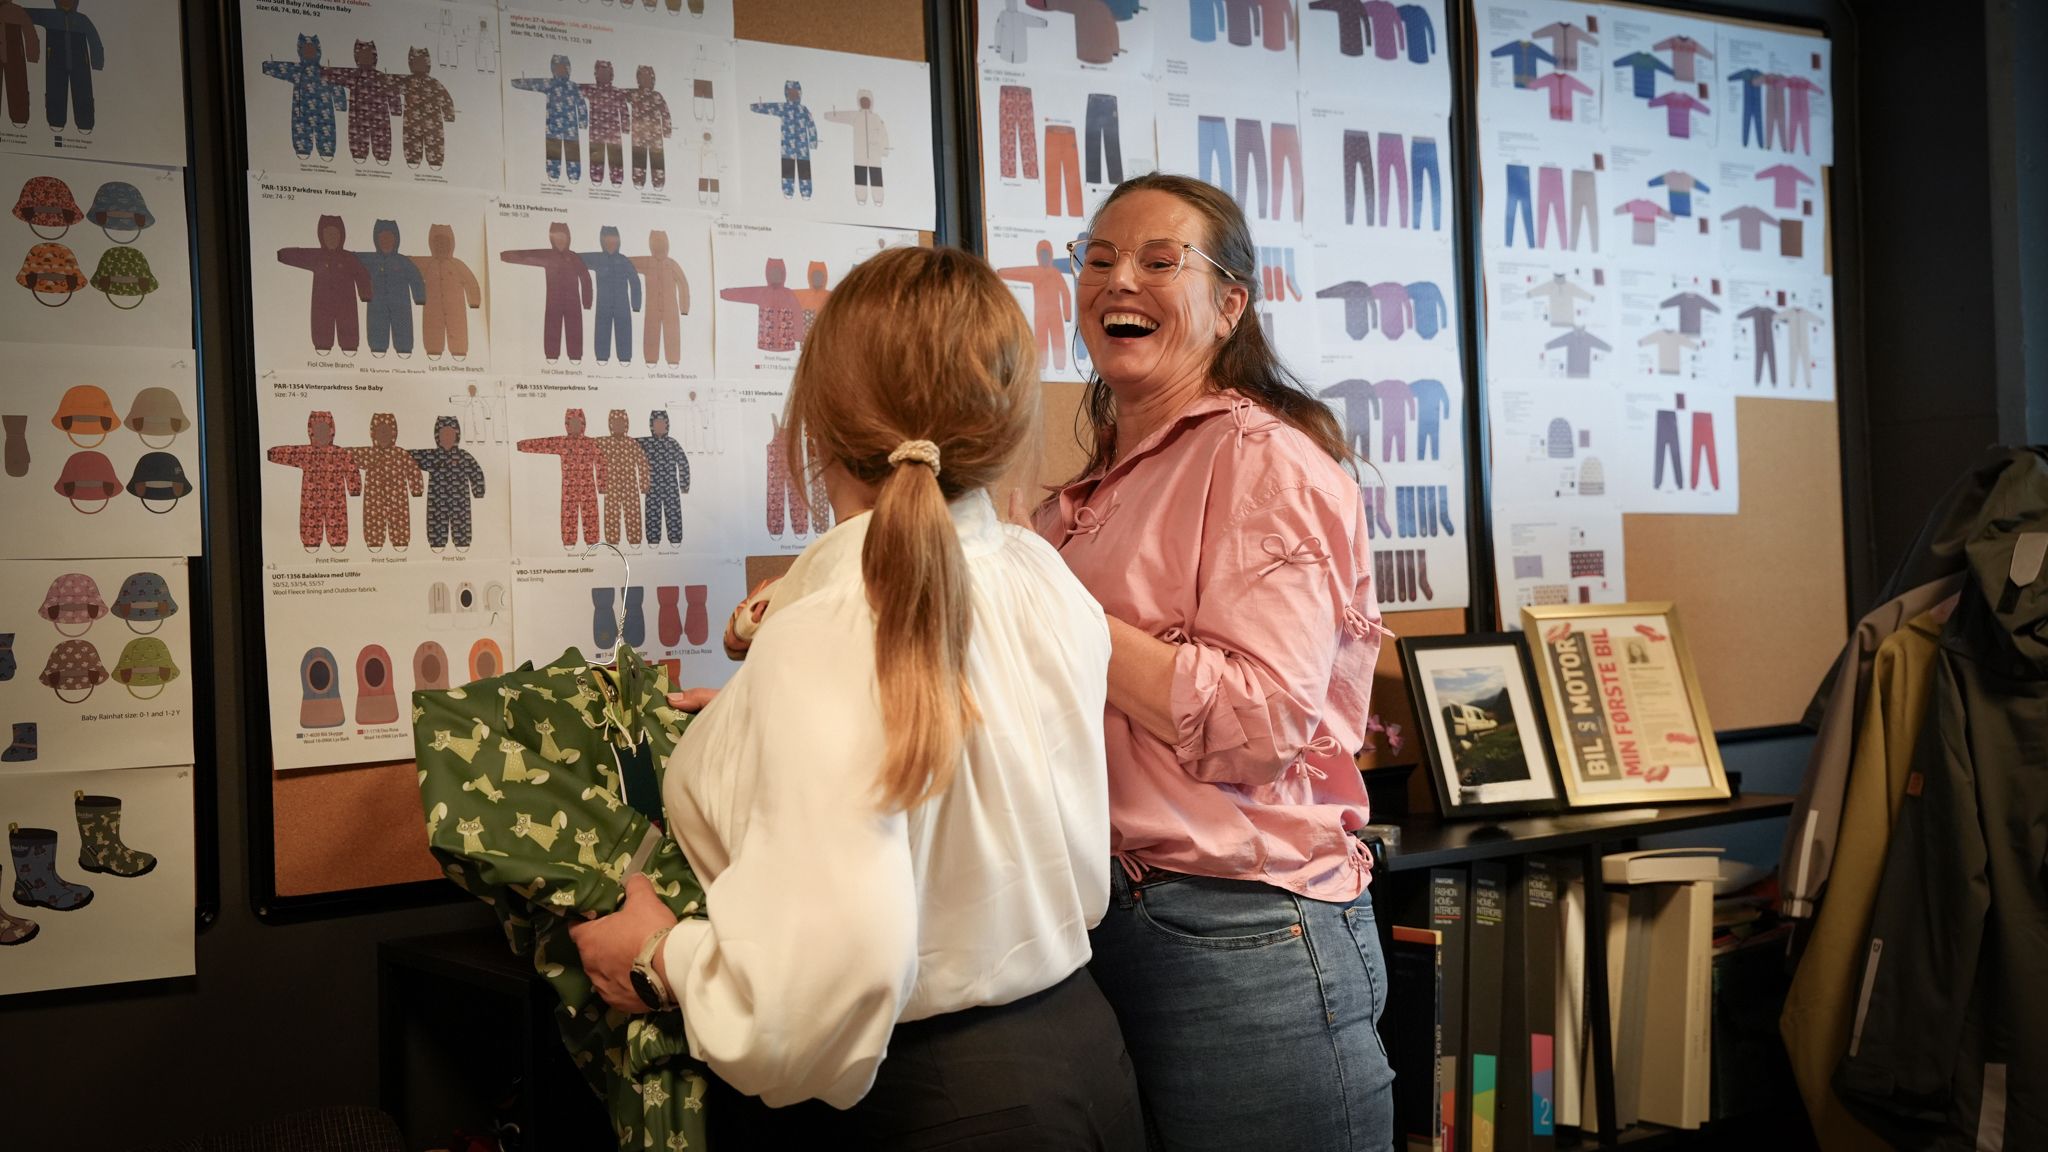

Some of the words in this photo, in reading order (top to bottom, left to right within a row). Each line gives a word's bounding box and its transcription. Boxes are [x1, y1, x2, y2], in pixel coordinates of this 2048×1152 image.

[306, 2, 335, 10] Vinddress
[336, 6, 352, 14] Baby
[261, 184, 292, 192] PAR-1353
[292, 186, 322, 195] Parkdress
[342, 190, 357, 198] Baby
[526, 204, 554, 213] Parkdress
[1592, 628, 1612, 656] BIL
[1556, 636, 1595, 714] MOTOR
[1598, 662, 1632, 735] FØRSTE
[1582, 738, 1611, 776] BIL
[1620, 741, 1644, 776] MIN
[1434, 887, 1458, 896] FASHION
[1540, 1098, 1550, 1125] 2
[1481, 1120, 1489, 1148] 3
